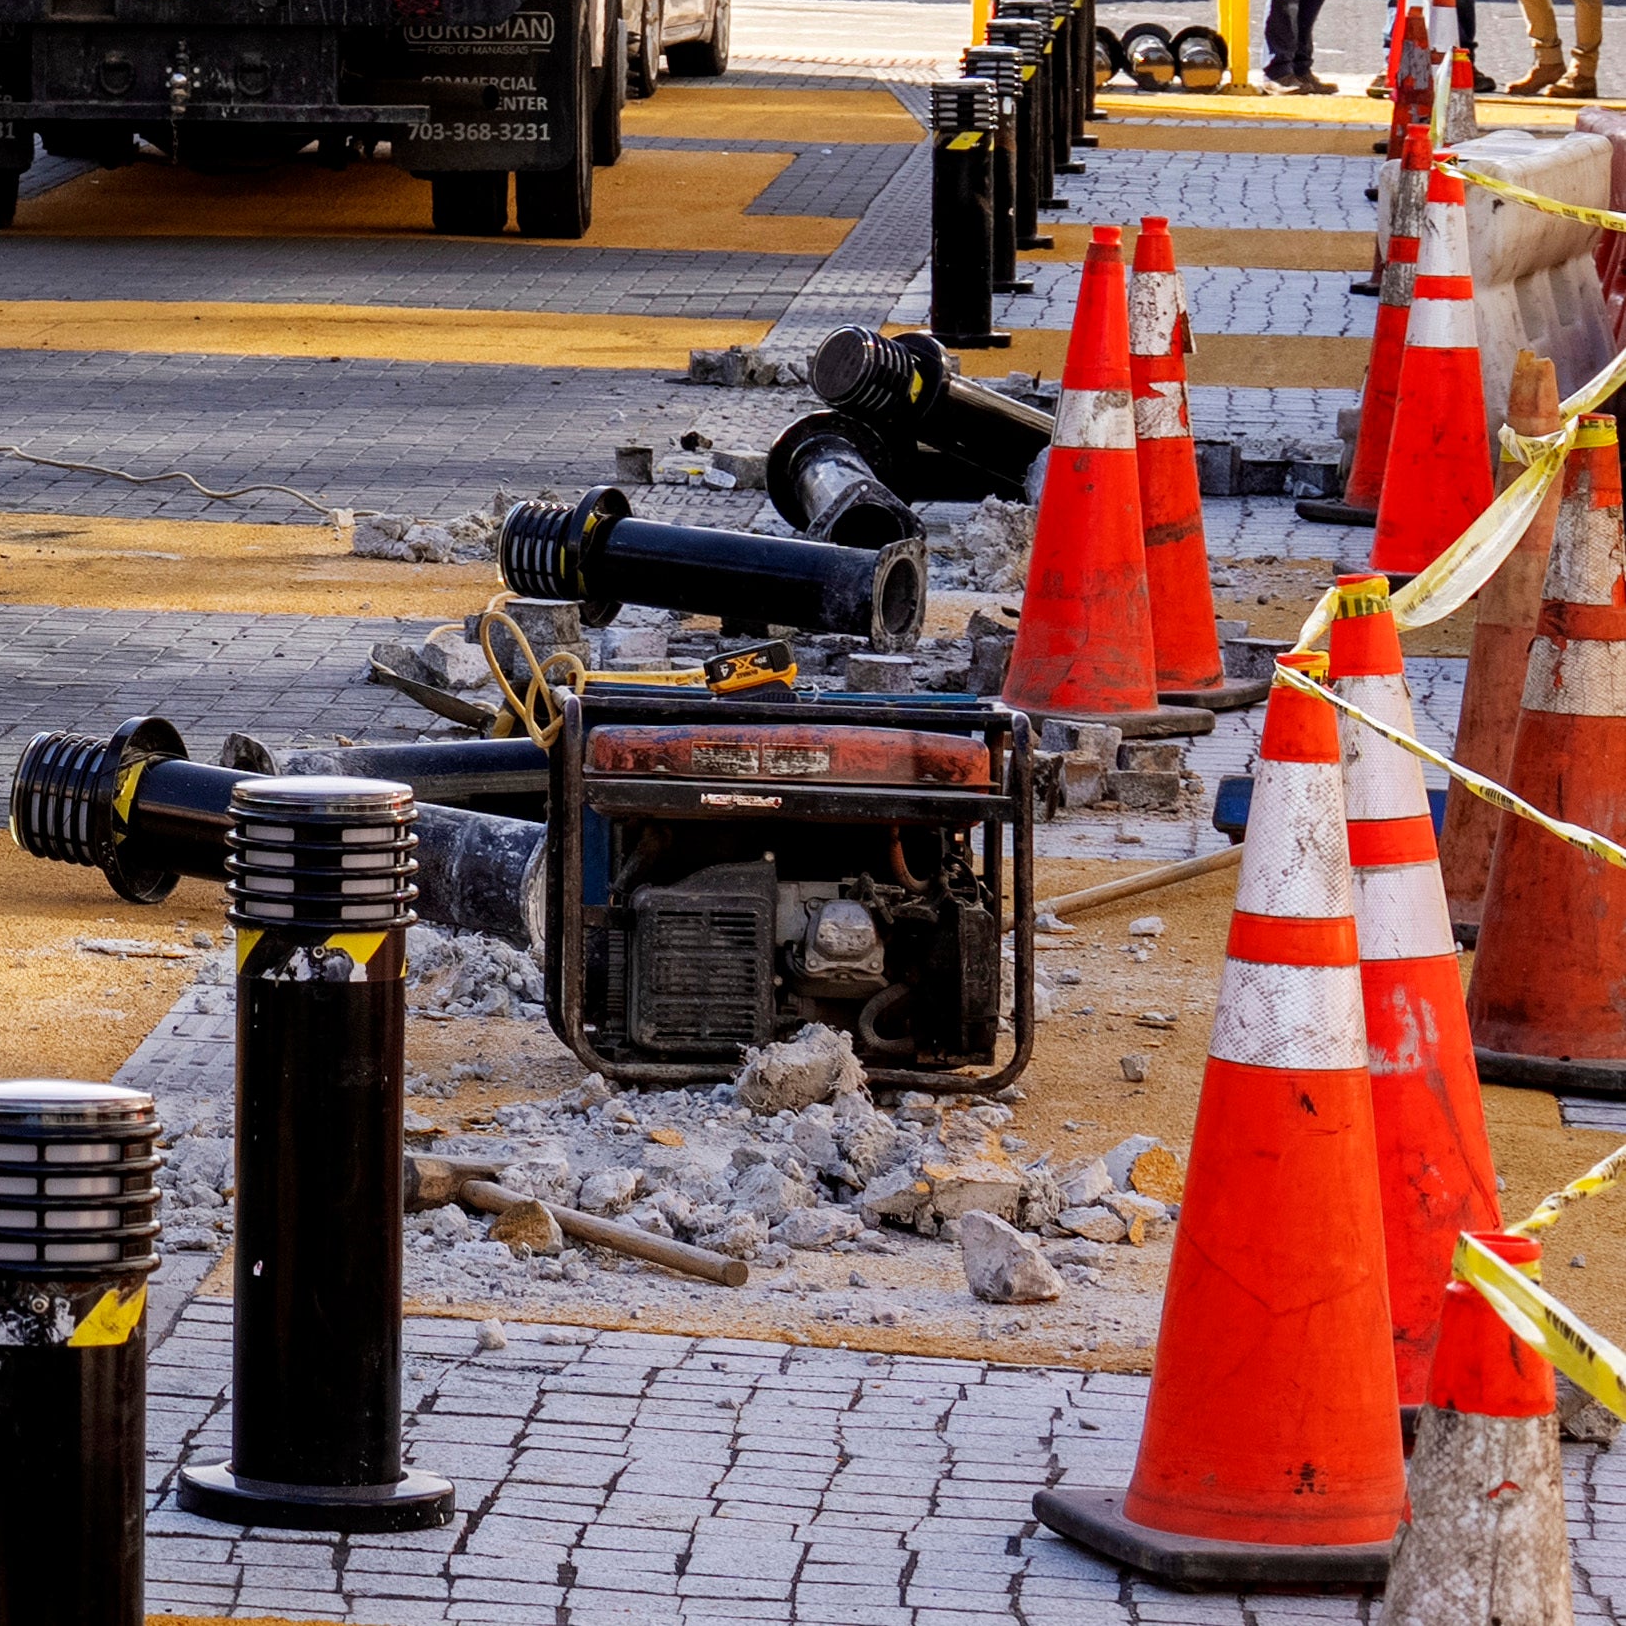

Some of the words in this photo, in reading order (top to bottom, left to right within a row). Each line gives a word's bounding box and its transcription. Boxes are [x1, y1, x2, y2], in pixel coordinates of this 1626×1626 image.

[457, 45, 472, 55] OF
[472, 45, 529, 55] MANASSAS
[495, 96, 549, 111] ENTER
[407, 122, 551, 141] 703-368-3231
